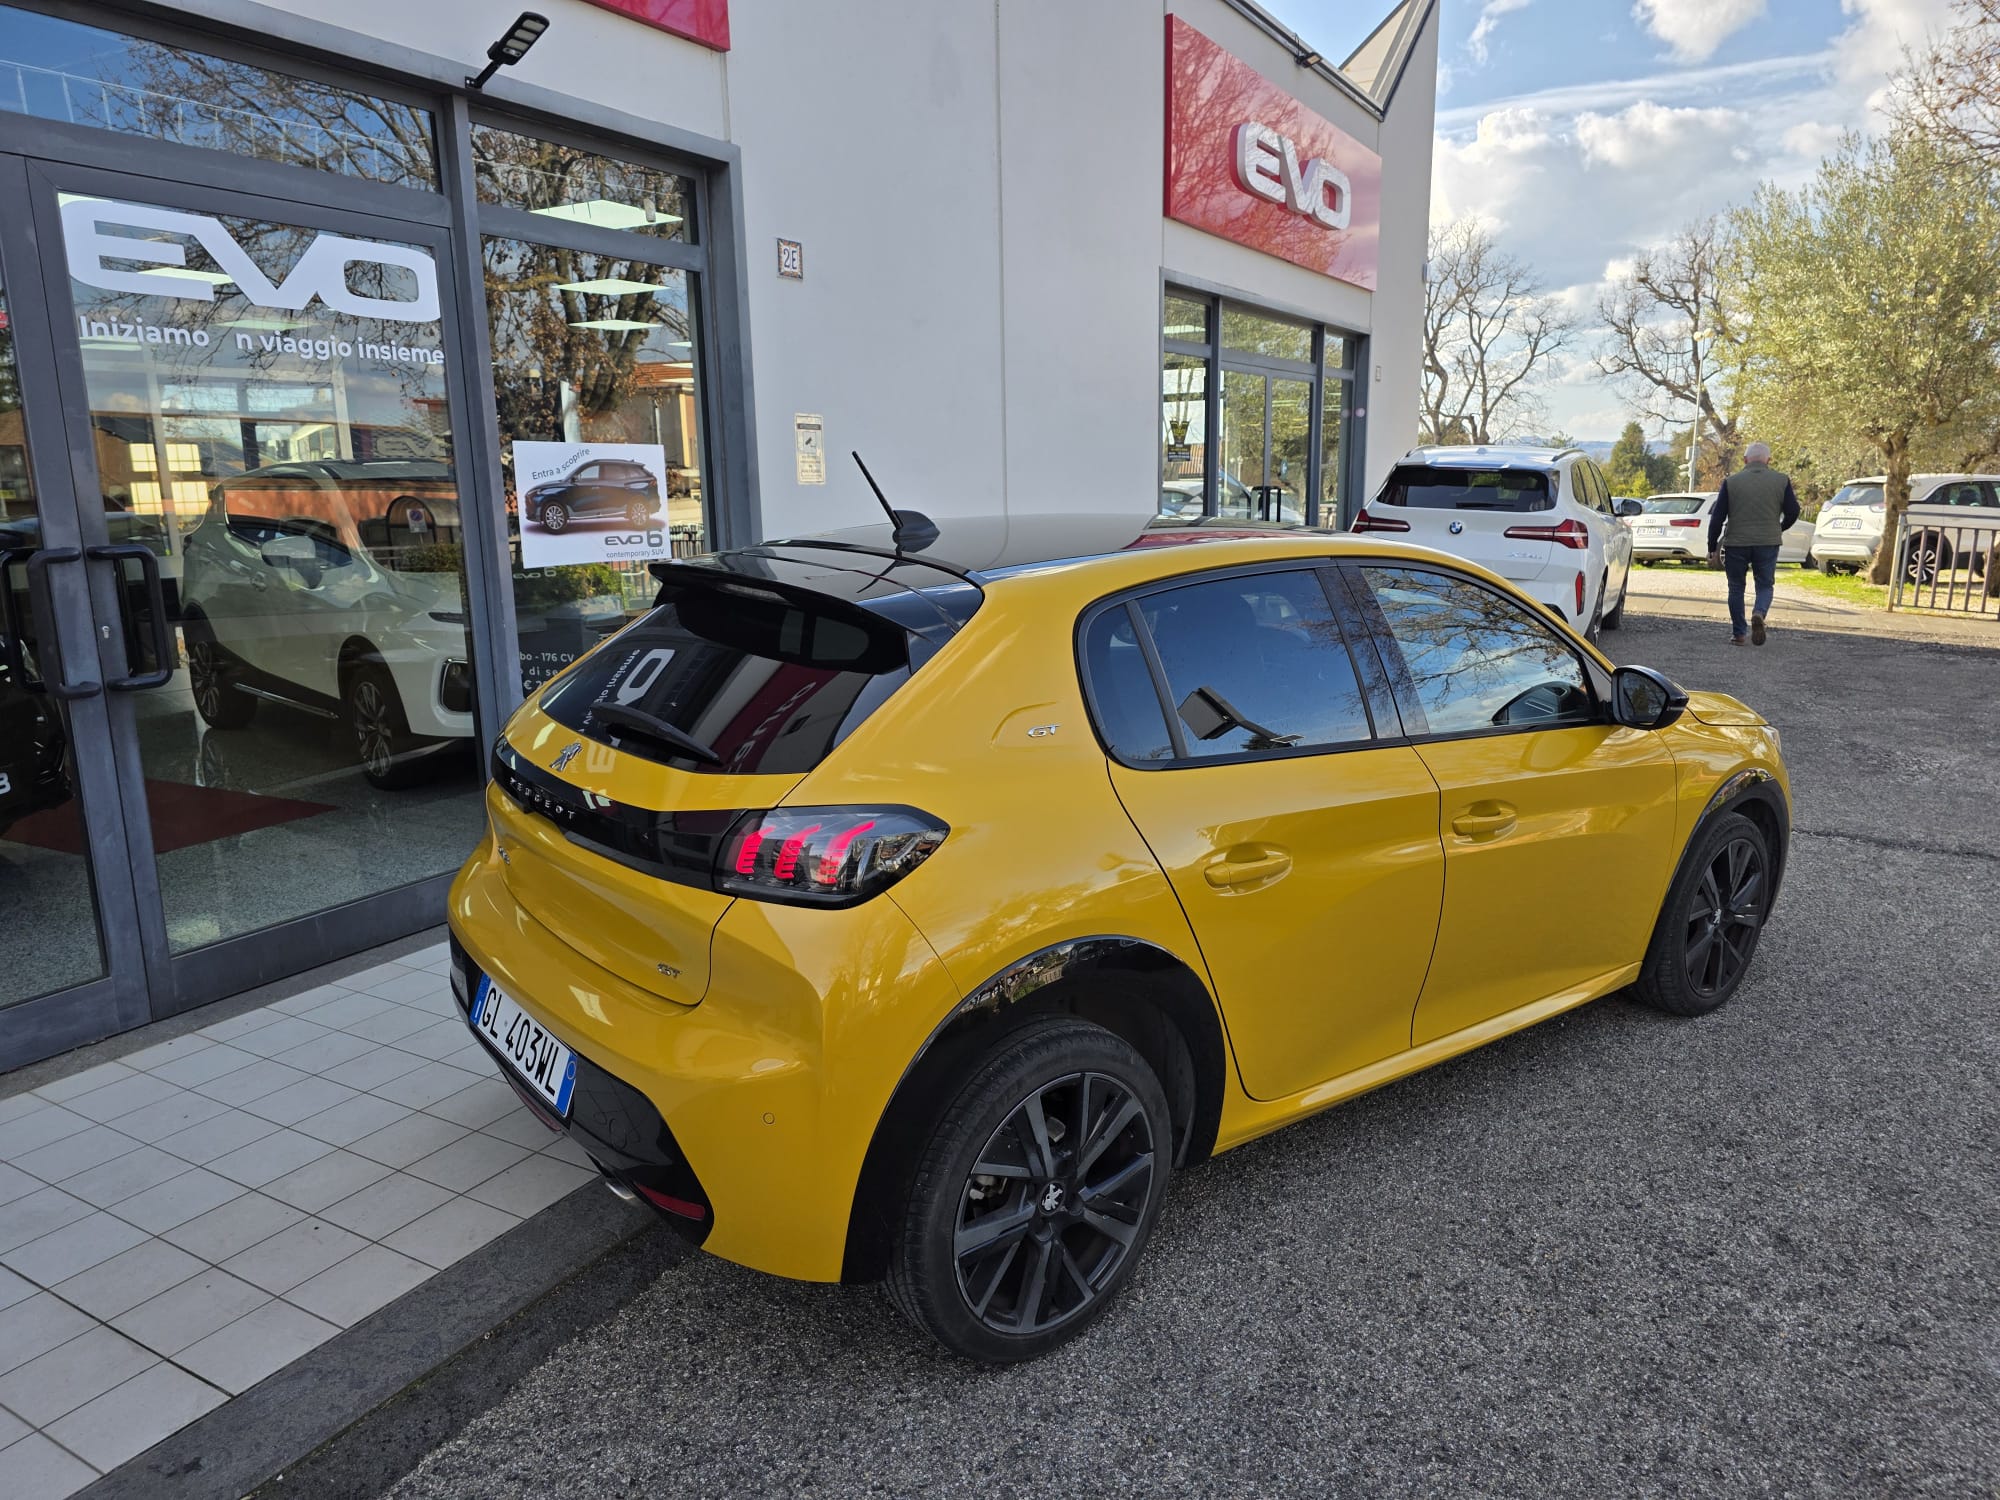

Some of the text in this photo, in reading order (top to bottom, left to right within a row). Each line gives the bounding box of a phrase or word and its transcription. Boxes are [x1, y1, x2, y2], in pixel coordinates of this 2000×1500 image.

[1236, 120, 1351, 230] EVO
[58, 199, 441, 322] EVO
[783, 248, 798, 270] 2E
[79, 315, 209, 347] Iniziamo
[259, 330, 351, 361] viaggio
[358, 337, 444, 364] insieme
[532, 468, 554, 480] Entra
[562, 448, 591, 471] scoprire
[604, 529, 663, 548] EVO 6
[606, 548, 665, 559] contemporary SUV
[529, 666, 540, 676] di
[541, 652, 558, 662] 176
[560, 653, 575, 663] CV
[1027, 723, 1061, 738] GT
[510, 776, 576, 820] PEUGEOT
[482, 987, 559, 1096] GL 403WL
